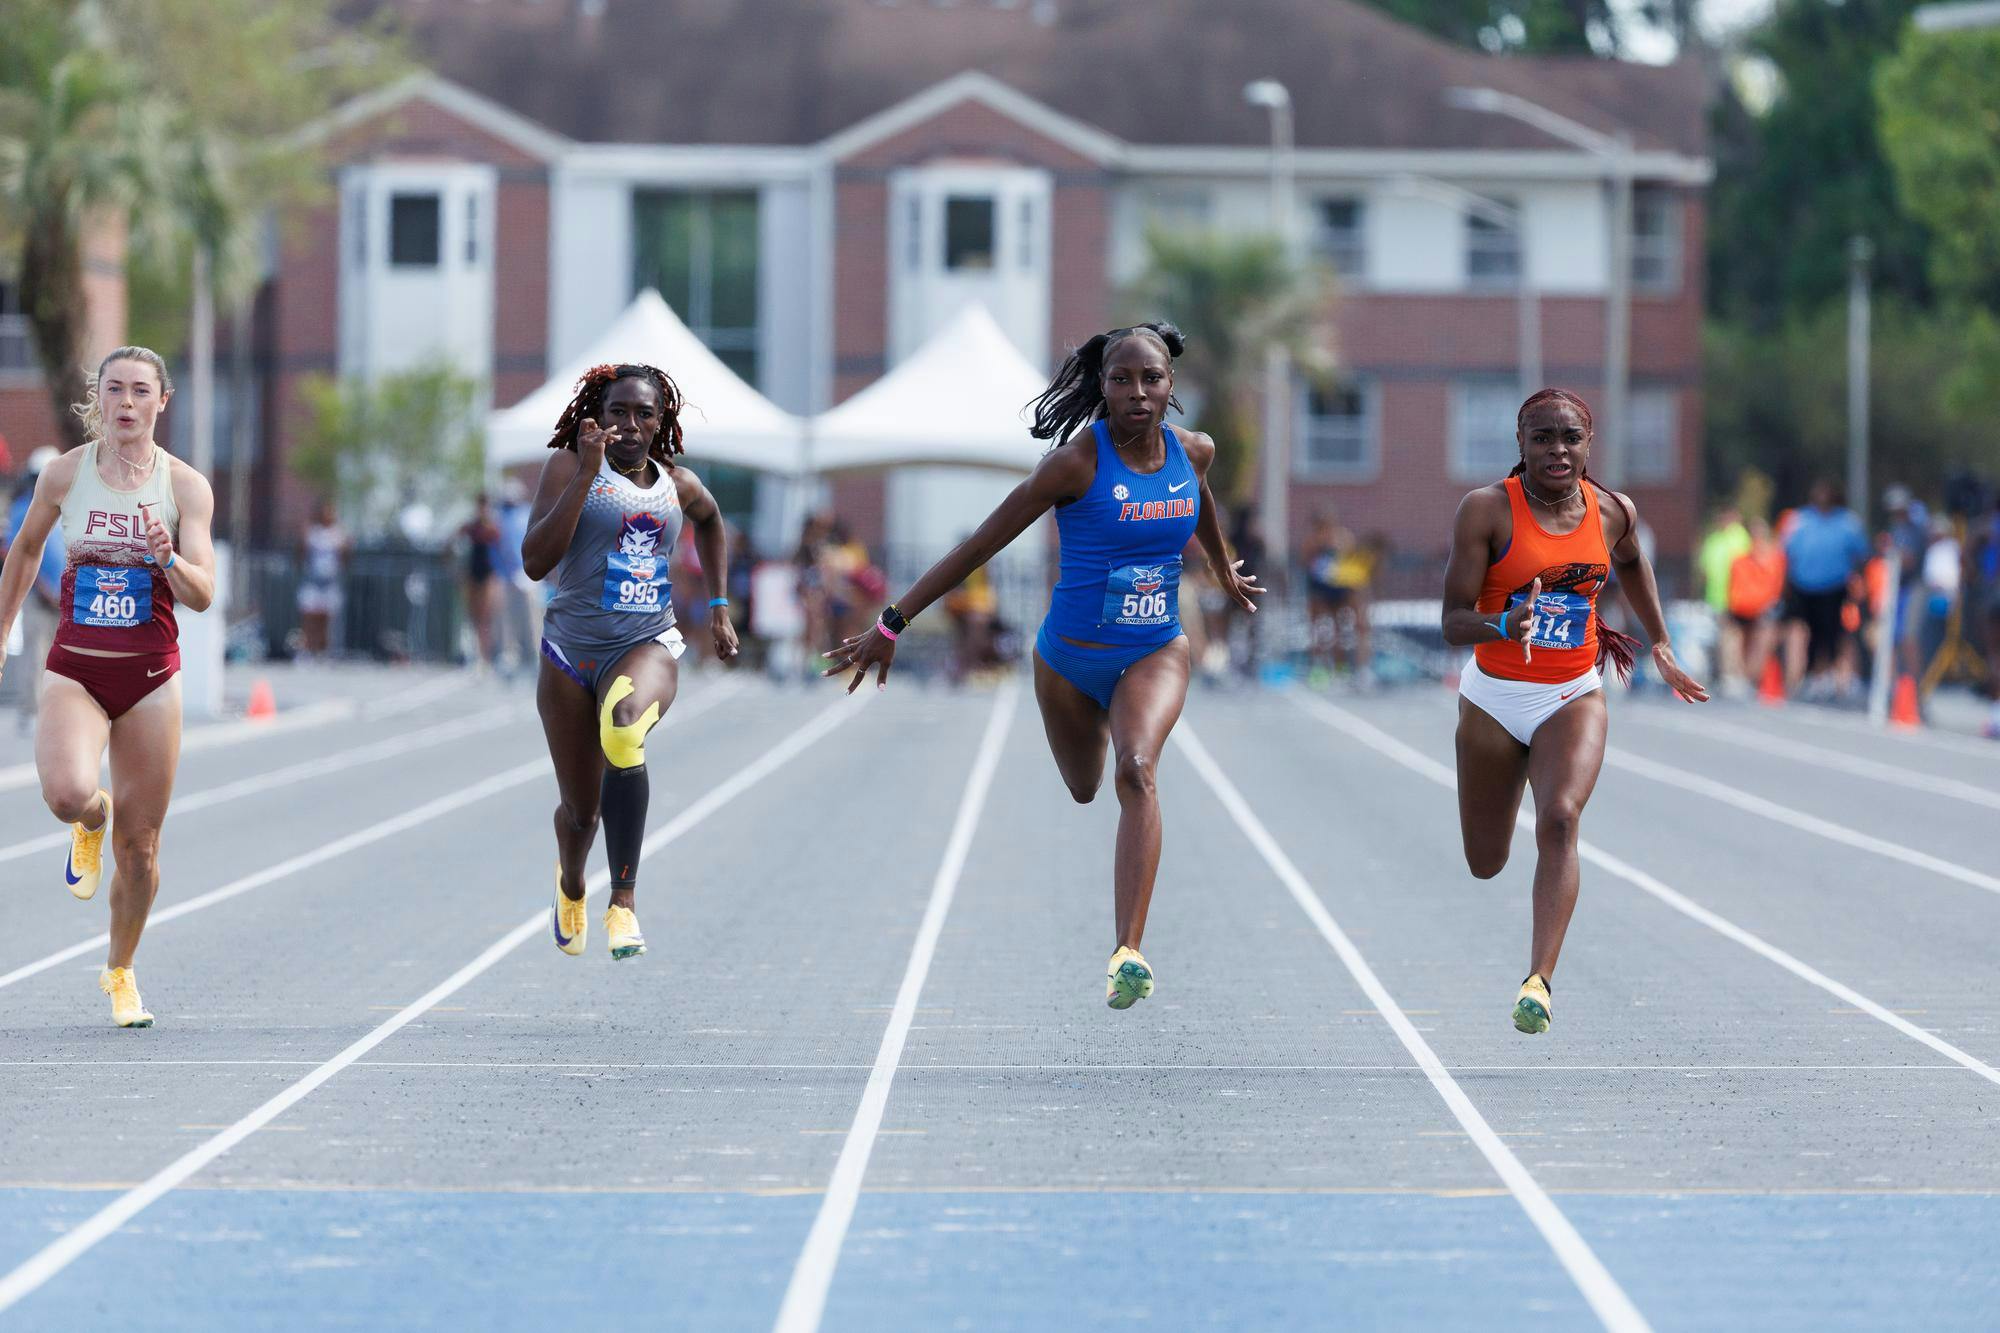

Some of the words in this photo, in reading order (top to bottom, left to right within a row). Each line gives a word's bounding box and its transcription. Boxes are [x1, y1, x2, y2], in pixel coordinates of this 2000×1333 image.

[1118, 498, 1195, 521] FLORIDA
[619, 580, 659, 604] 995
[89, 594, 136, 619] 460
[1122, 592, 1167, 618] 506
[1530, 639, 1563, 649] NESVILLE,
